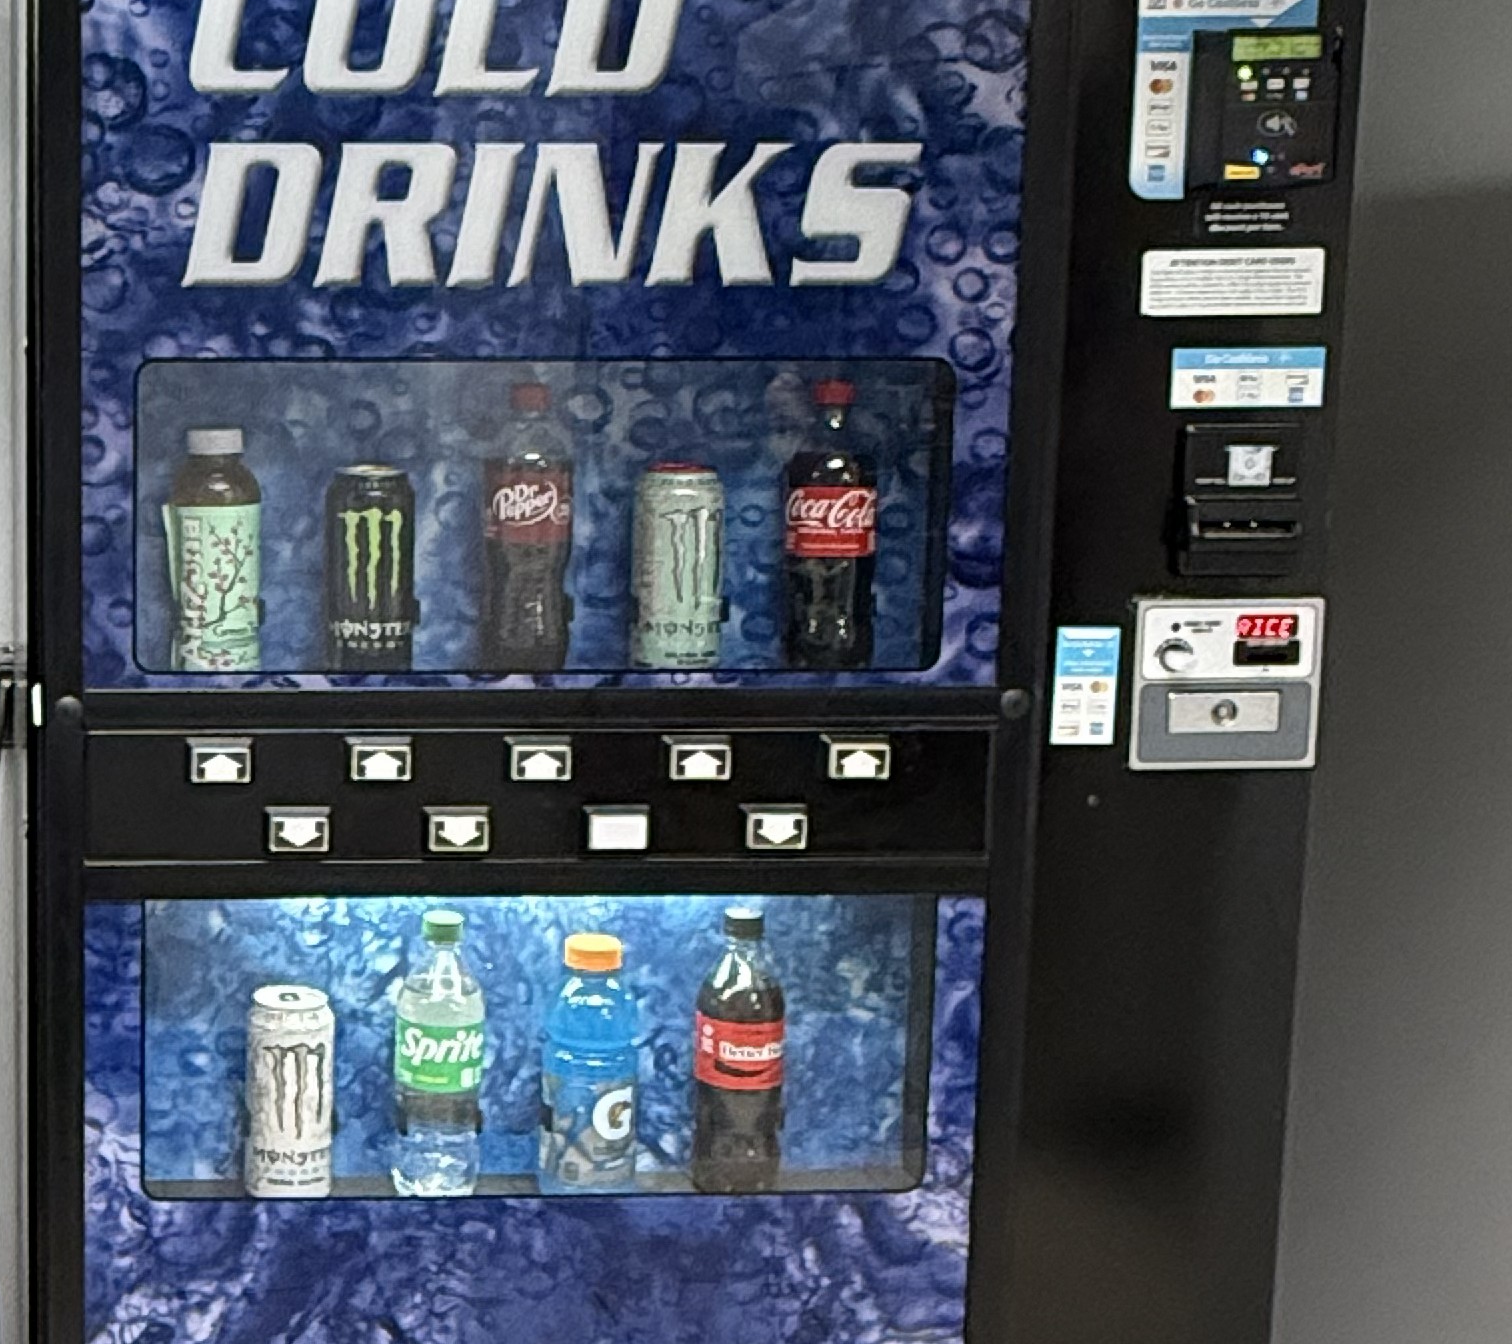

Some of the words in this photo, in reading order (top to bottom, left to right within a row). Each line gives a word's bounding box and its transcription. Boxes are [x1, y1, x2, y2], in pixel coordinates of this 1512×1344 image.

[181, 143, 923, 288] DRINKS
[495, 488, 555, 522] Pepper
[513, 484, 540, 502] Dr
[401, 1028, 485, 1066] Sprit
[592, 1088, 633, 1141] G
